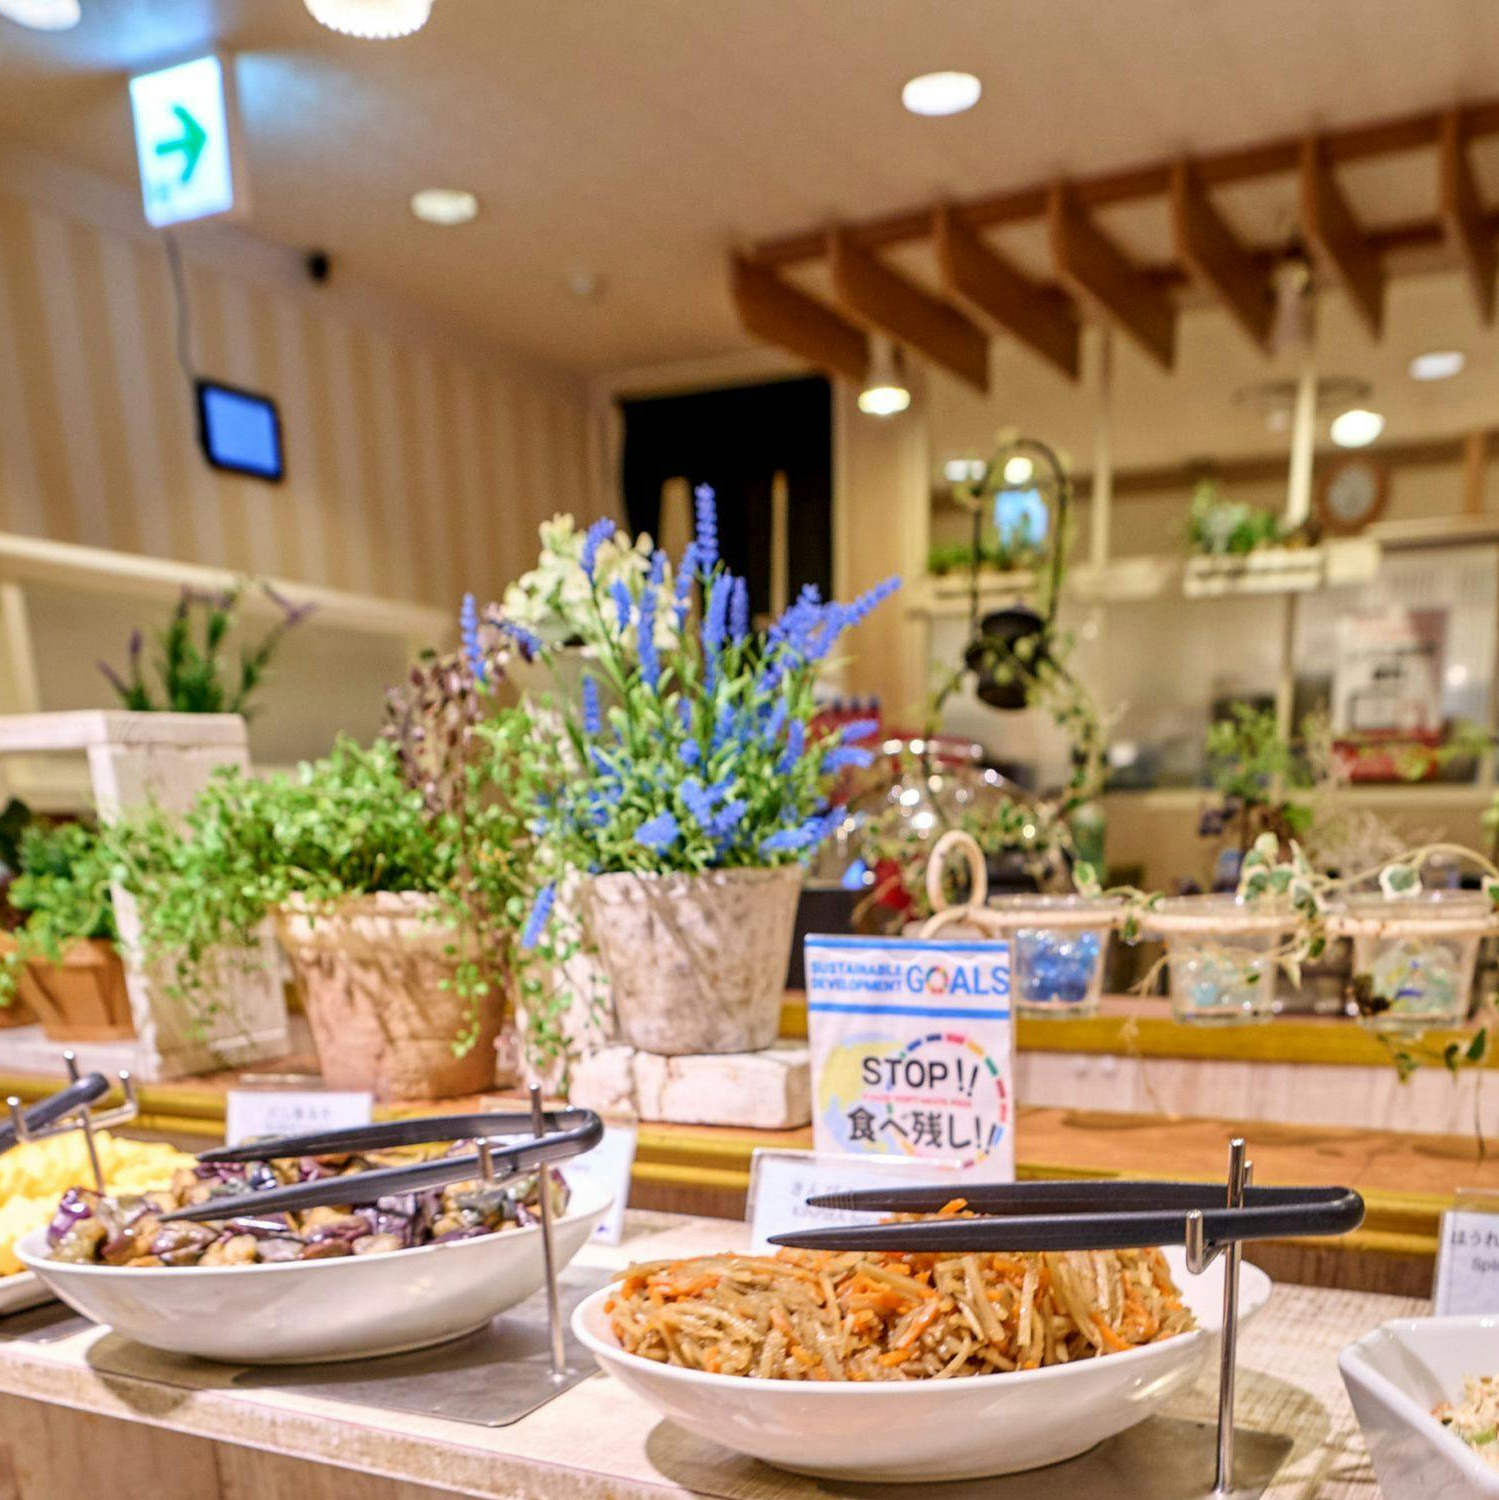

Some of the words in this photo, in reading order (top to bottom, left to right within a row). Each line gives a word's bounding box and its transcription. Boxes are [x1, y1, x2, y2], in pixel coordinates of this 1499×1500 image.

[811, 961, 902, 977] SUSTAINABLE
[811, 979, 902, 993] DEVELOPMENT
[906, 965, 1011, 996] GOALS
